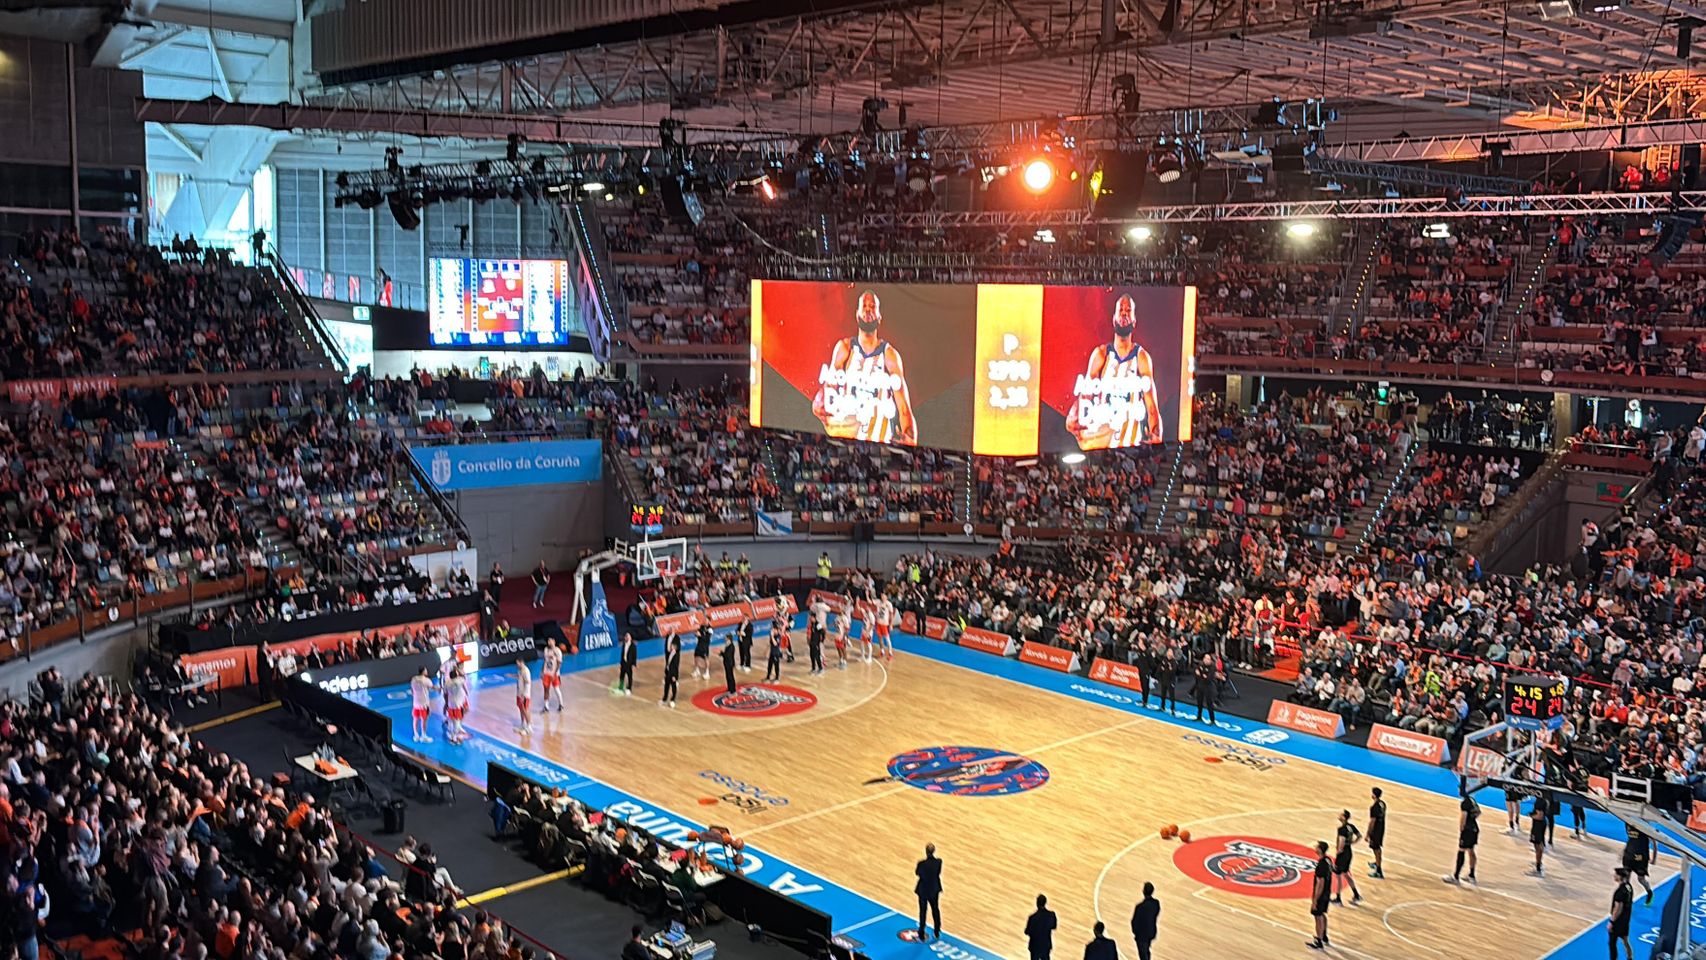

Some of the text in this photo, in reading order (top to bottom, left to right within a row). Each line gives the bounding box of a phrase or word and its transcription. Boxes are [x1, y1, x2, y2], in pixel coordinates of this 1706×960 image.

[458, 455, 580, 474] Concello da Coruña
[480, 636, 535, 657] endesa
[1511, 697, 1537, 716] 24
[1467, 748, 1505, 775] LEYM
[769, 871, 824, 896] A
